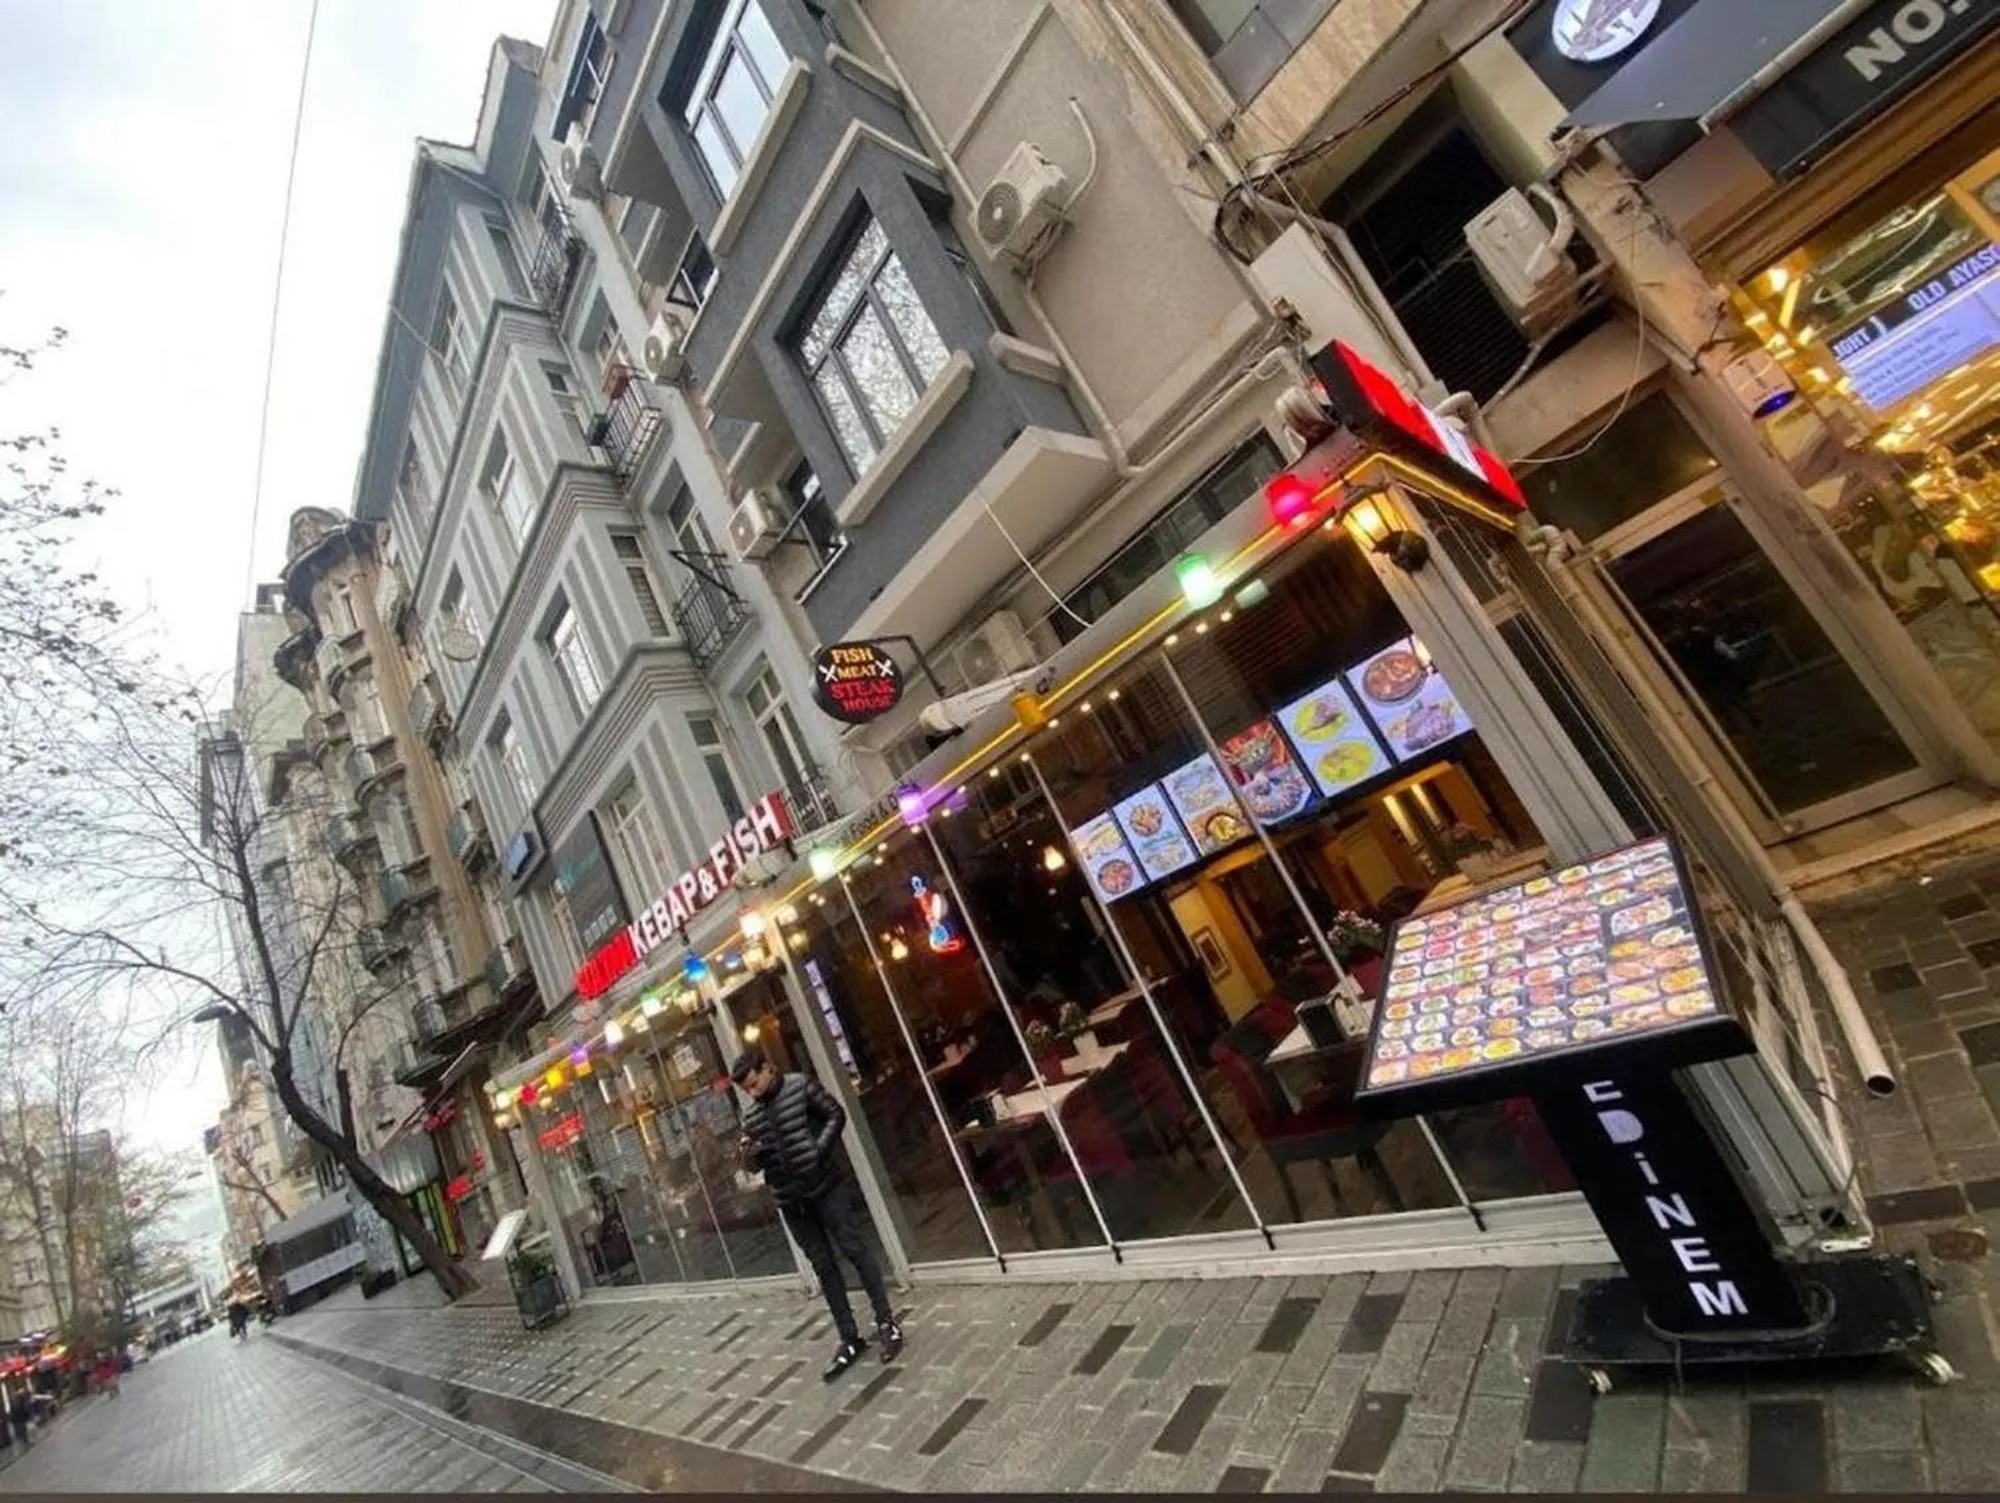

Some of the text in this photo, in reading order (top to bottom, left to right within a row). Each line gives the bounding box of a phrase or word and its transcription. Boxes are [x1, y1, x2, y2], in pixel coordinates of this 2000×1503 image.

[1907, 281, 1946, 311] OLD
[832, 647, 875, 663] FISH
[837, 663, 877, 679] MEAT
[831, 679, 895, 699] STEAK
[843, 697, 893, 713] HOUSE
